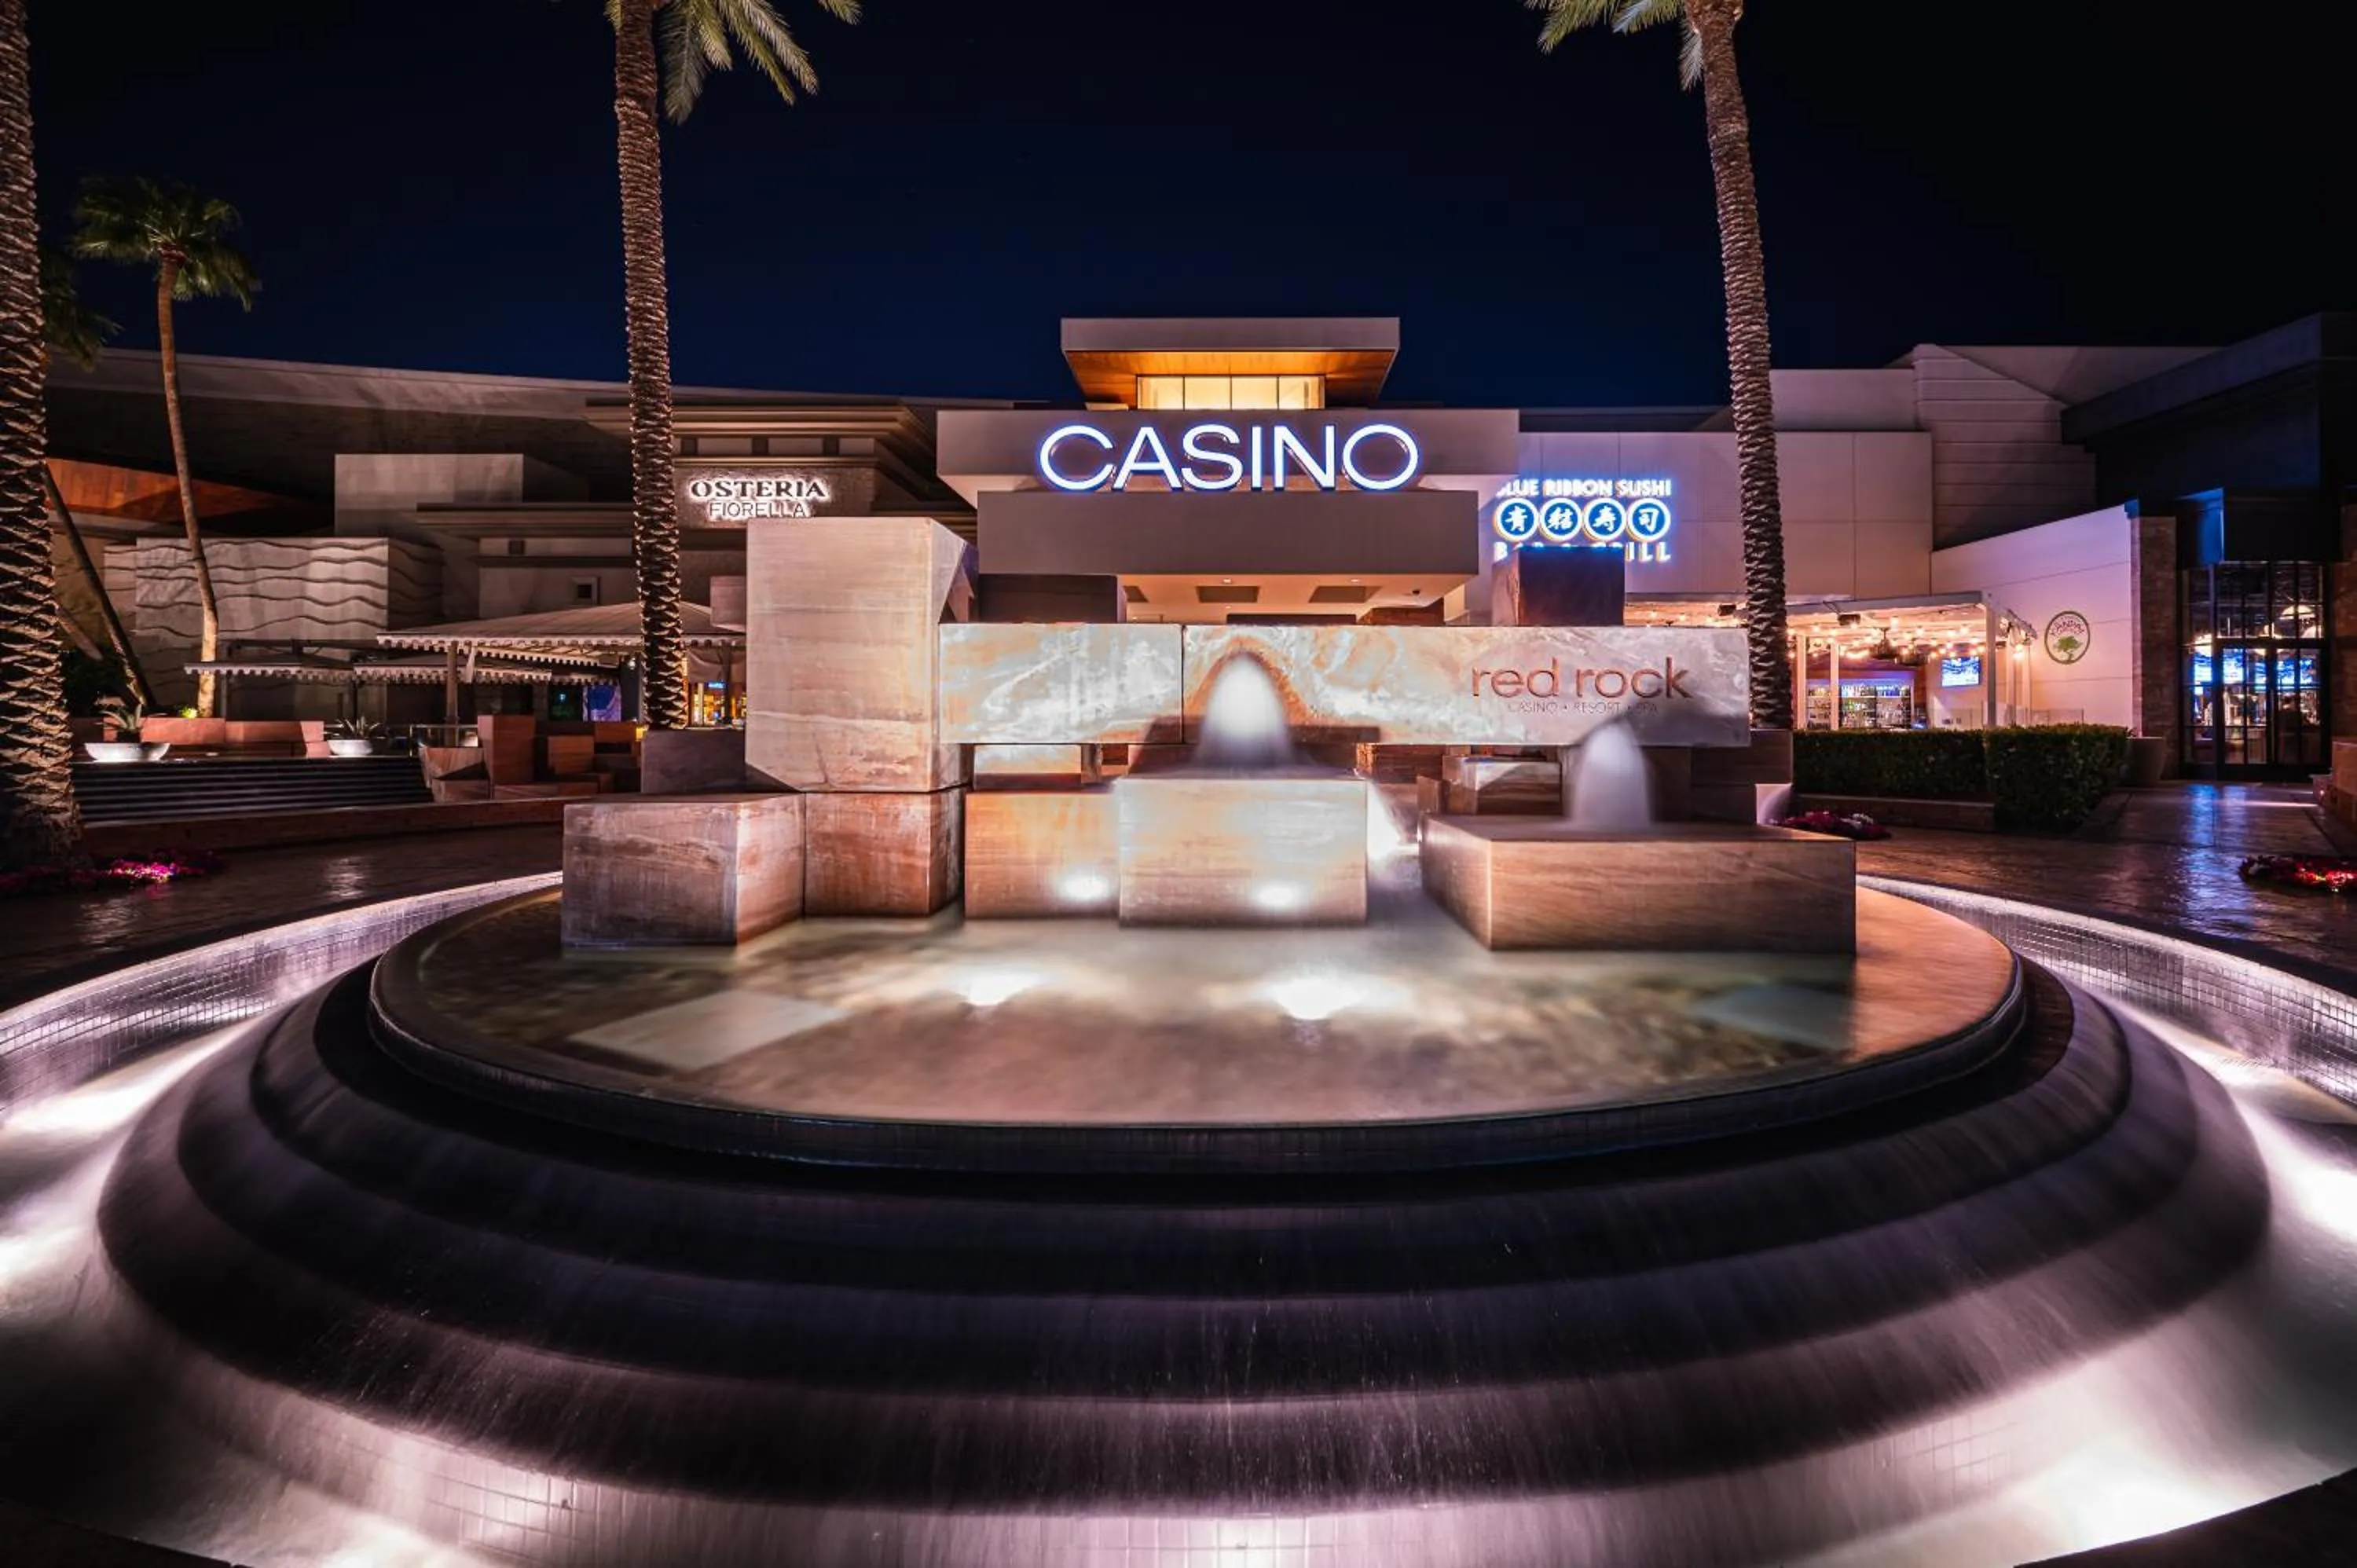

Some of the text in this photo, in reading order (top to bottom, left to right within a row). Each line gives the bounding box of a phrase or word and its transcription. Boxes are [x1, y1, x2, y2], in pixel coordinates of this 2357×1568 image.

[1039, 423, 1419, 491] CASINO
[691, 479, 826, 498] OSTERIA
[1542, 478, 1613, 496] RIBBON
[1617, 478, 1672, 496] SUSHI
[709, 502, 807, 518] FIORELLA
[1472, 657, 1693, 698] red rock
[1507, 701, 1560, 715] CASINO
[1574, 701, 1621, 715] RESORT
